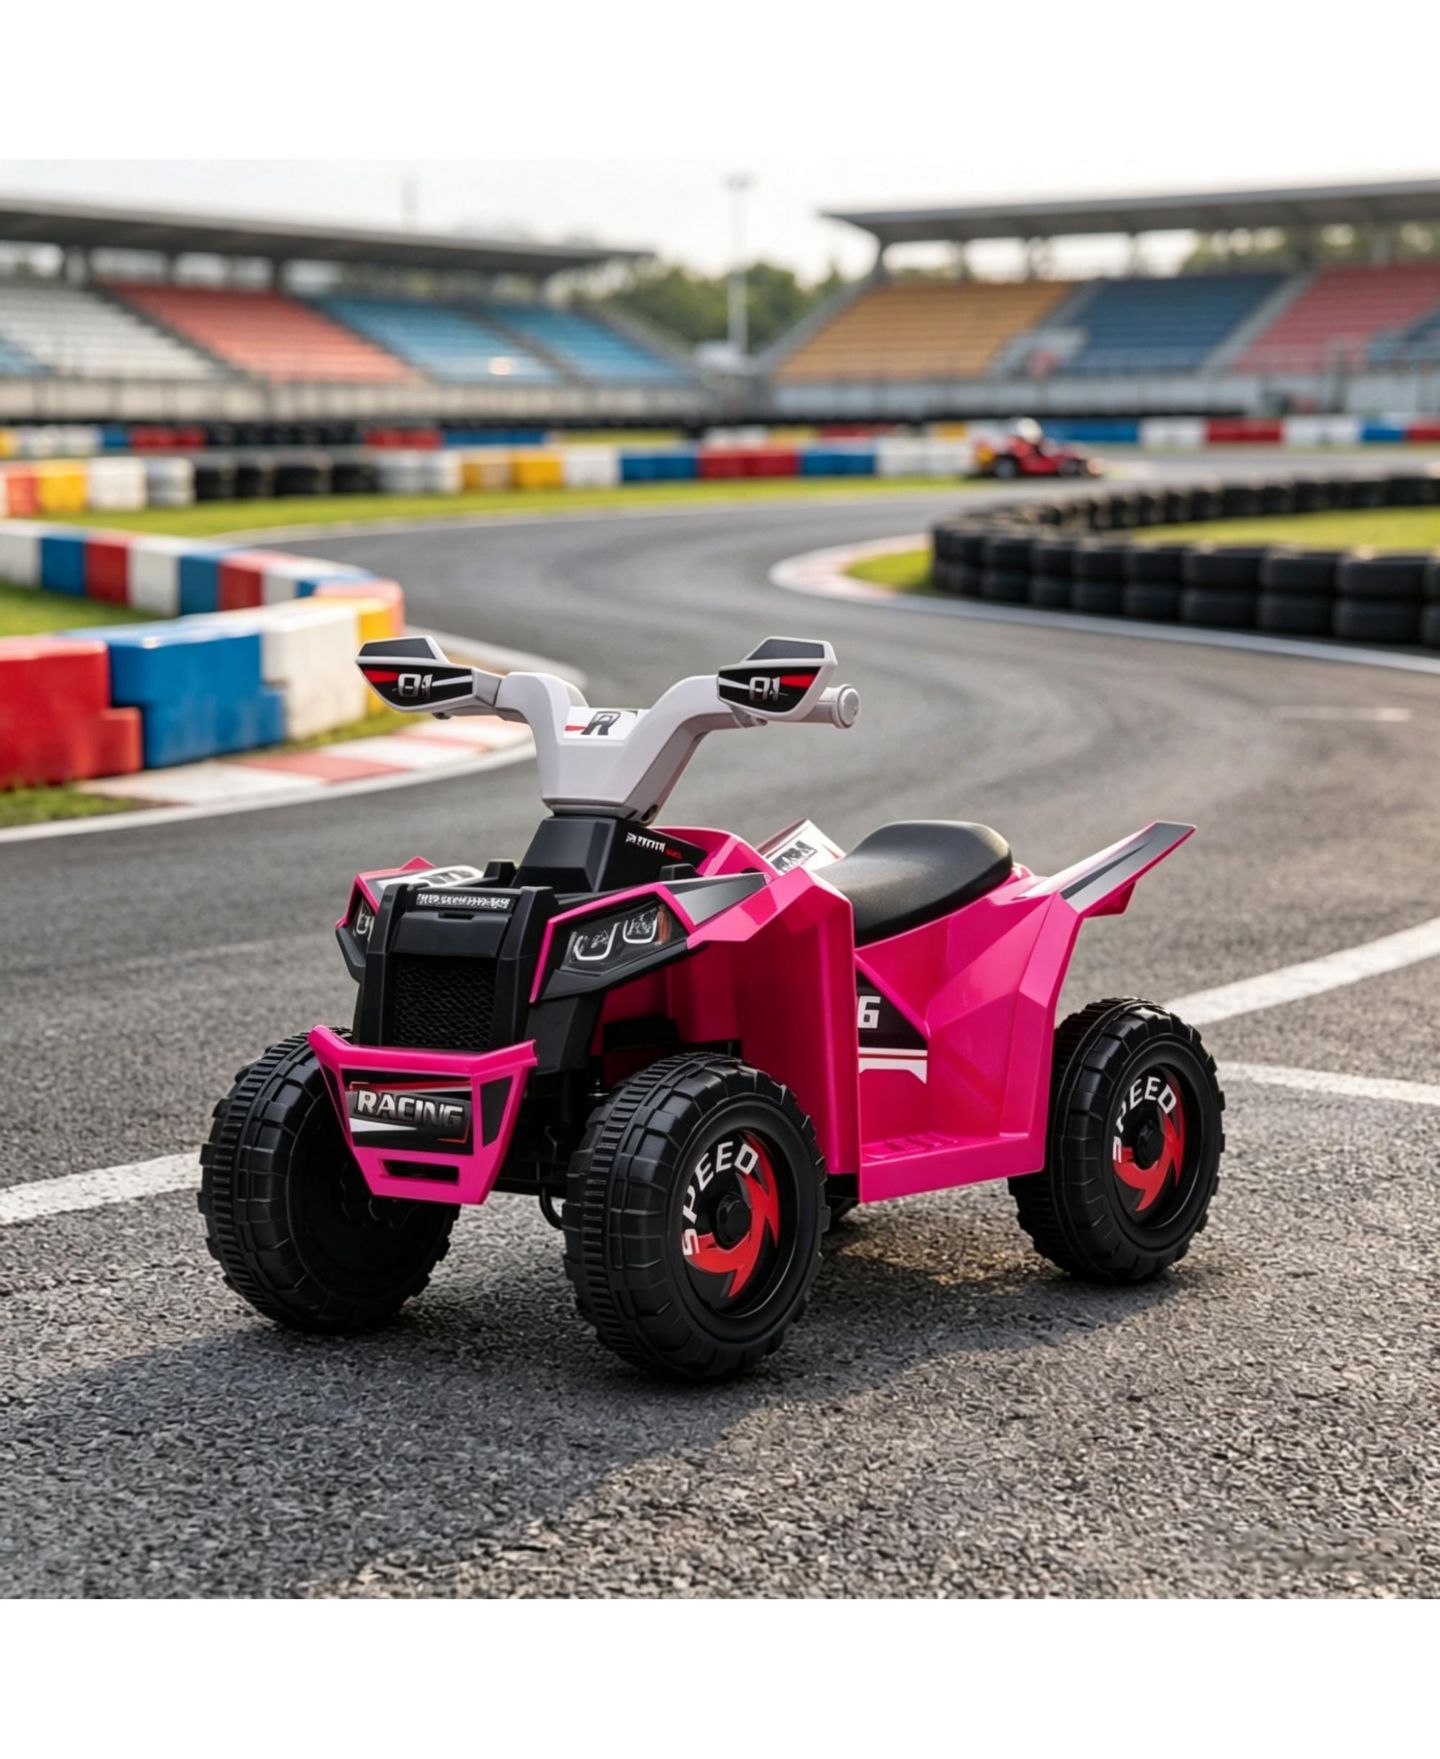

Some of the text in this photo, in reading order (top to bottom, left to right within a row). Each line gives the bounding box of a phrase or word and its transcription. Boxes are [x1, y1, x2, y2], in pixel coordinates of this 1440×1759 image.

[580, 710, 621, 736] R
[857, 995, 881, 1029] 6
[357, 1089, 463, 1128] RACING
[681, 1141, 759, 1256] SPEED
